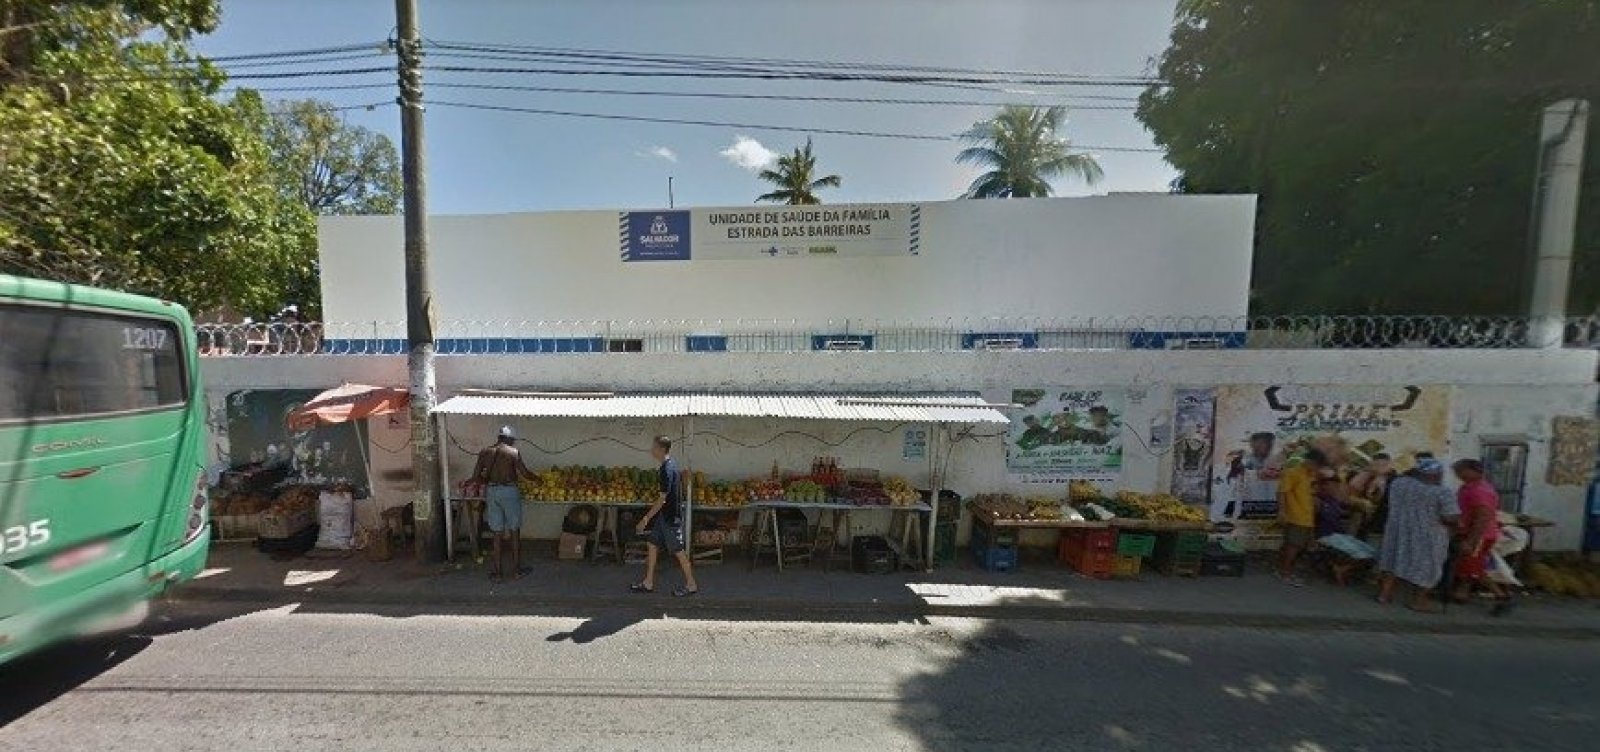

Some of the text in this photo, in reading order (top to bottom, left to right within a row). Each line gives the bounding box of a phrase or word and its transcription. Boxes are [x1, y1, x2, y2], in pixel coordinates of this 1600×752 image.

[709, 207, 891, 225] UNIDADE DE SAÚDE DA FAMÍLIA
[727, 224, 871, 239] ESTRADA DAS BARREIRAS
[121, 327, 166, 349] 1207
[0, 518, 51, 556] 35
